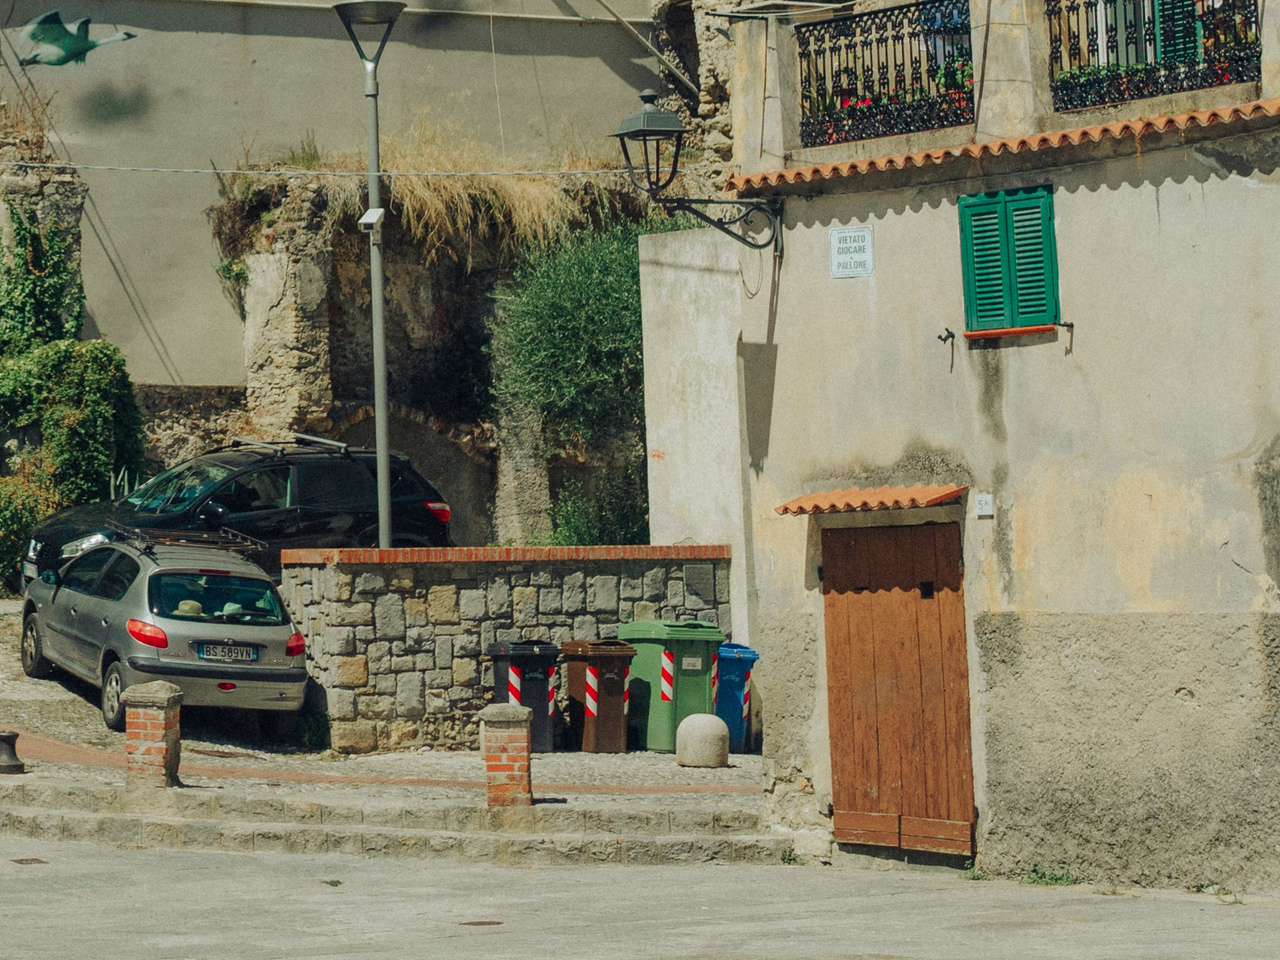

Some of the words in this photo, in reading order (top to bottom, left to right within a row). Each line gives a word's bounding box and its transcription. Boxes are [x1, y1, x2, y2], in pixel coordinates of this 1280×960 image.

[837, 234, 866, 245] VIETATO
[837, 245, 867, 256] GIOCARE
[837, 260, 868, 271] PALLONE
[205, 645, 218, 657] BS
[220, 646, 252, 660] 589VN
